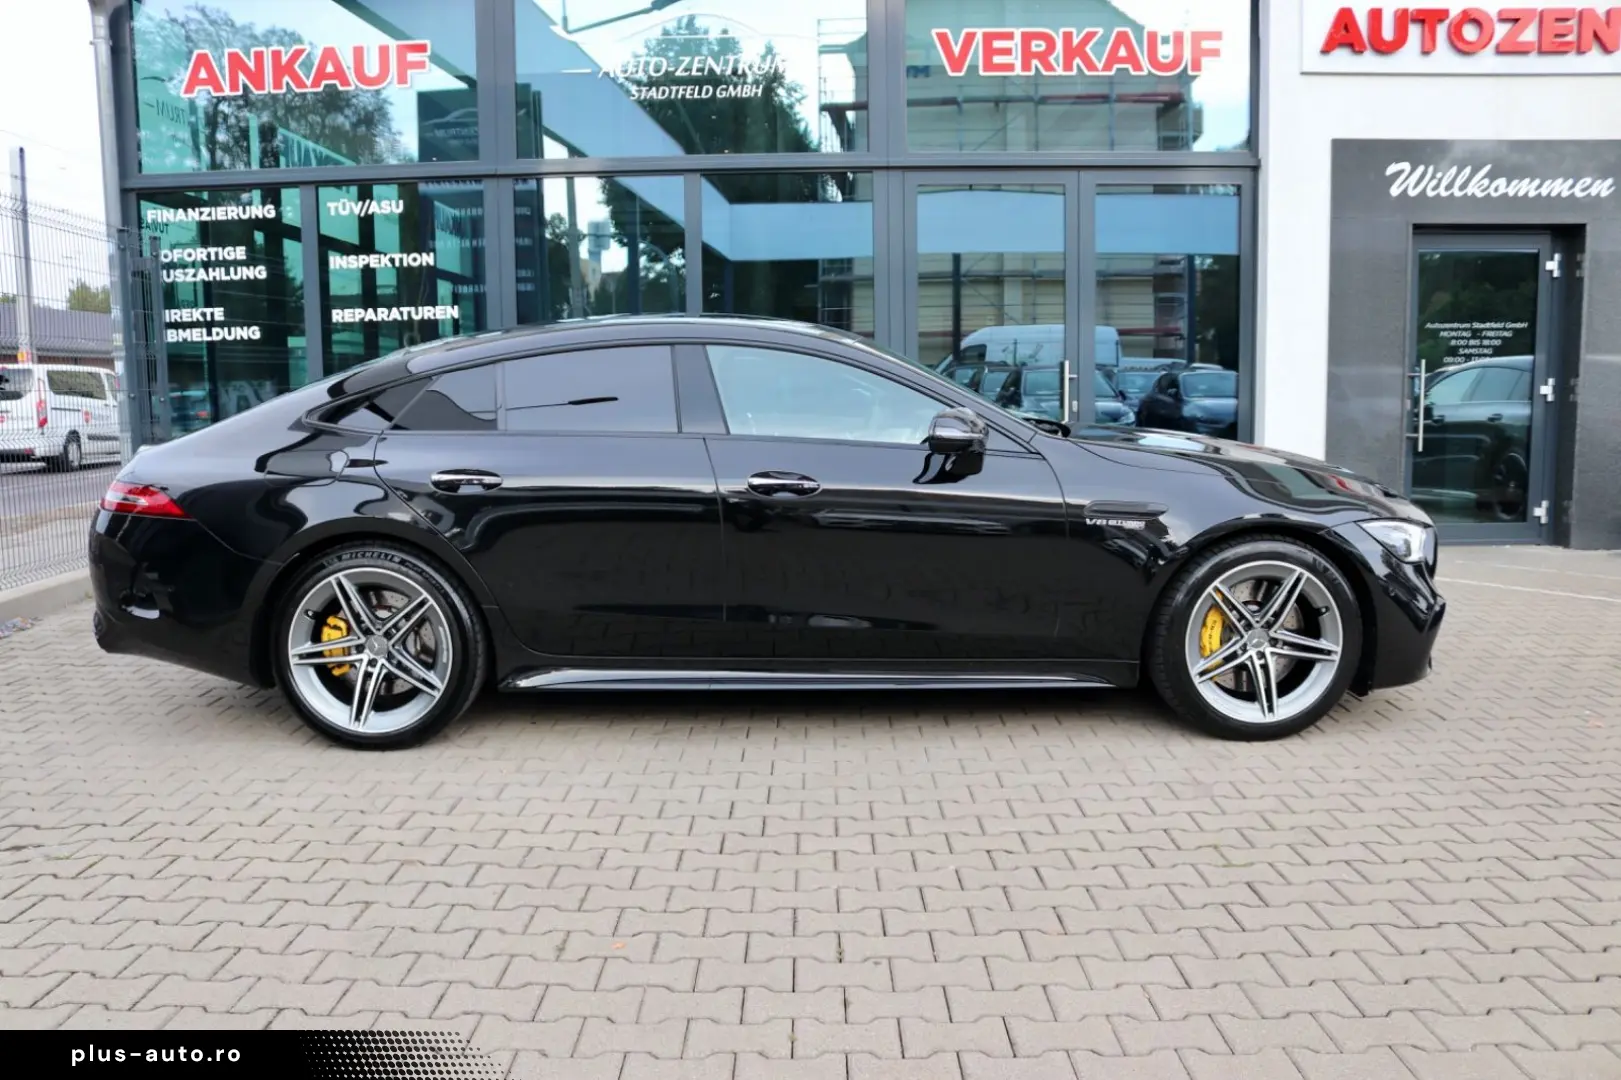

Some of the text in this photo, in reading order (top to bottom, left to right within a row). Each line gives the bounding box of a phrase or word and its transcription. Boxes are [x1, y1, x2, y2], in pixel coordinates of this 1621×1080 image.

[1320, 7, 1621, 54] AUTOZEN
[933, 29, 1222, 76] VERKAUF
[181, 41, 431, 97] ANKAUF
[630, 84, 763, 100] STADTFELD GMBH
[1385, 161, 1616, 198] Willkommen
[147, 204, 276, 223] FINANZIERUNG
[327, 199, 404, 216] TÜV/ASU
[161, 246, 247, 262] OFORTIGE
[329, 252, 435, 269] INSPEKTION
[162, 265, 267, 283] USZAHLUNG
[165, 307, 225, 323] IREKTE
[331, 305, 459, 323] REPARATUREN
[165, 326, 261, 342] BMELDUNG
[341, 550, 402, 564] MICHELIN
